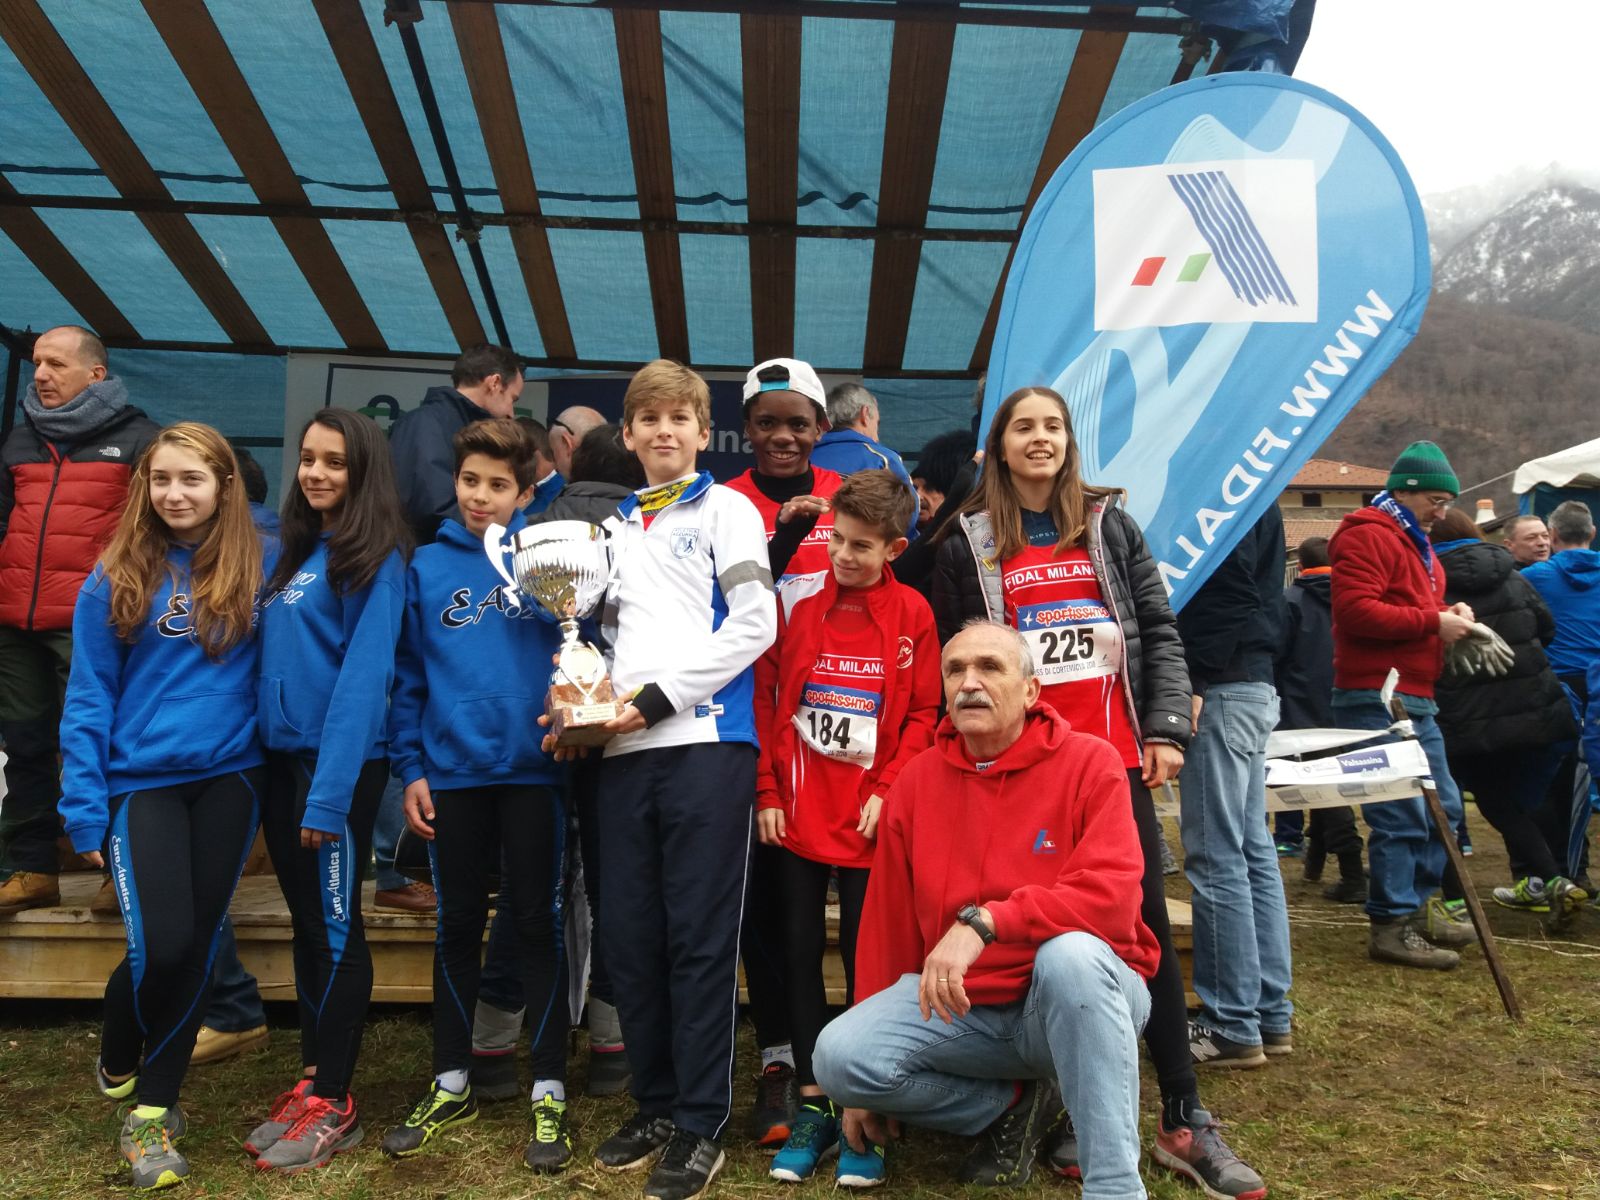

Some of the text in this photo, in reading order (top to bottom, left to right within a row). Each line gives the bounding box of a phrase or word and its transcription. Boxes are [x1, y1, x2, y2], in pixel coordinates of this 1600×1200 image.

[1004, 570, 1044, 589] FIDAL
[1039, 627, 1095, 666] 225
[806, 710, 851, 750] 184
